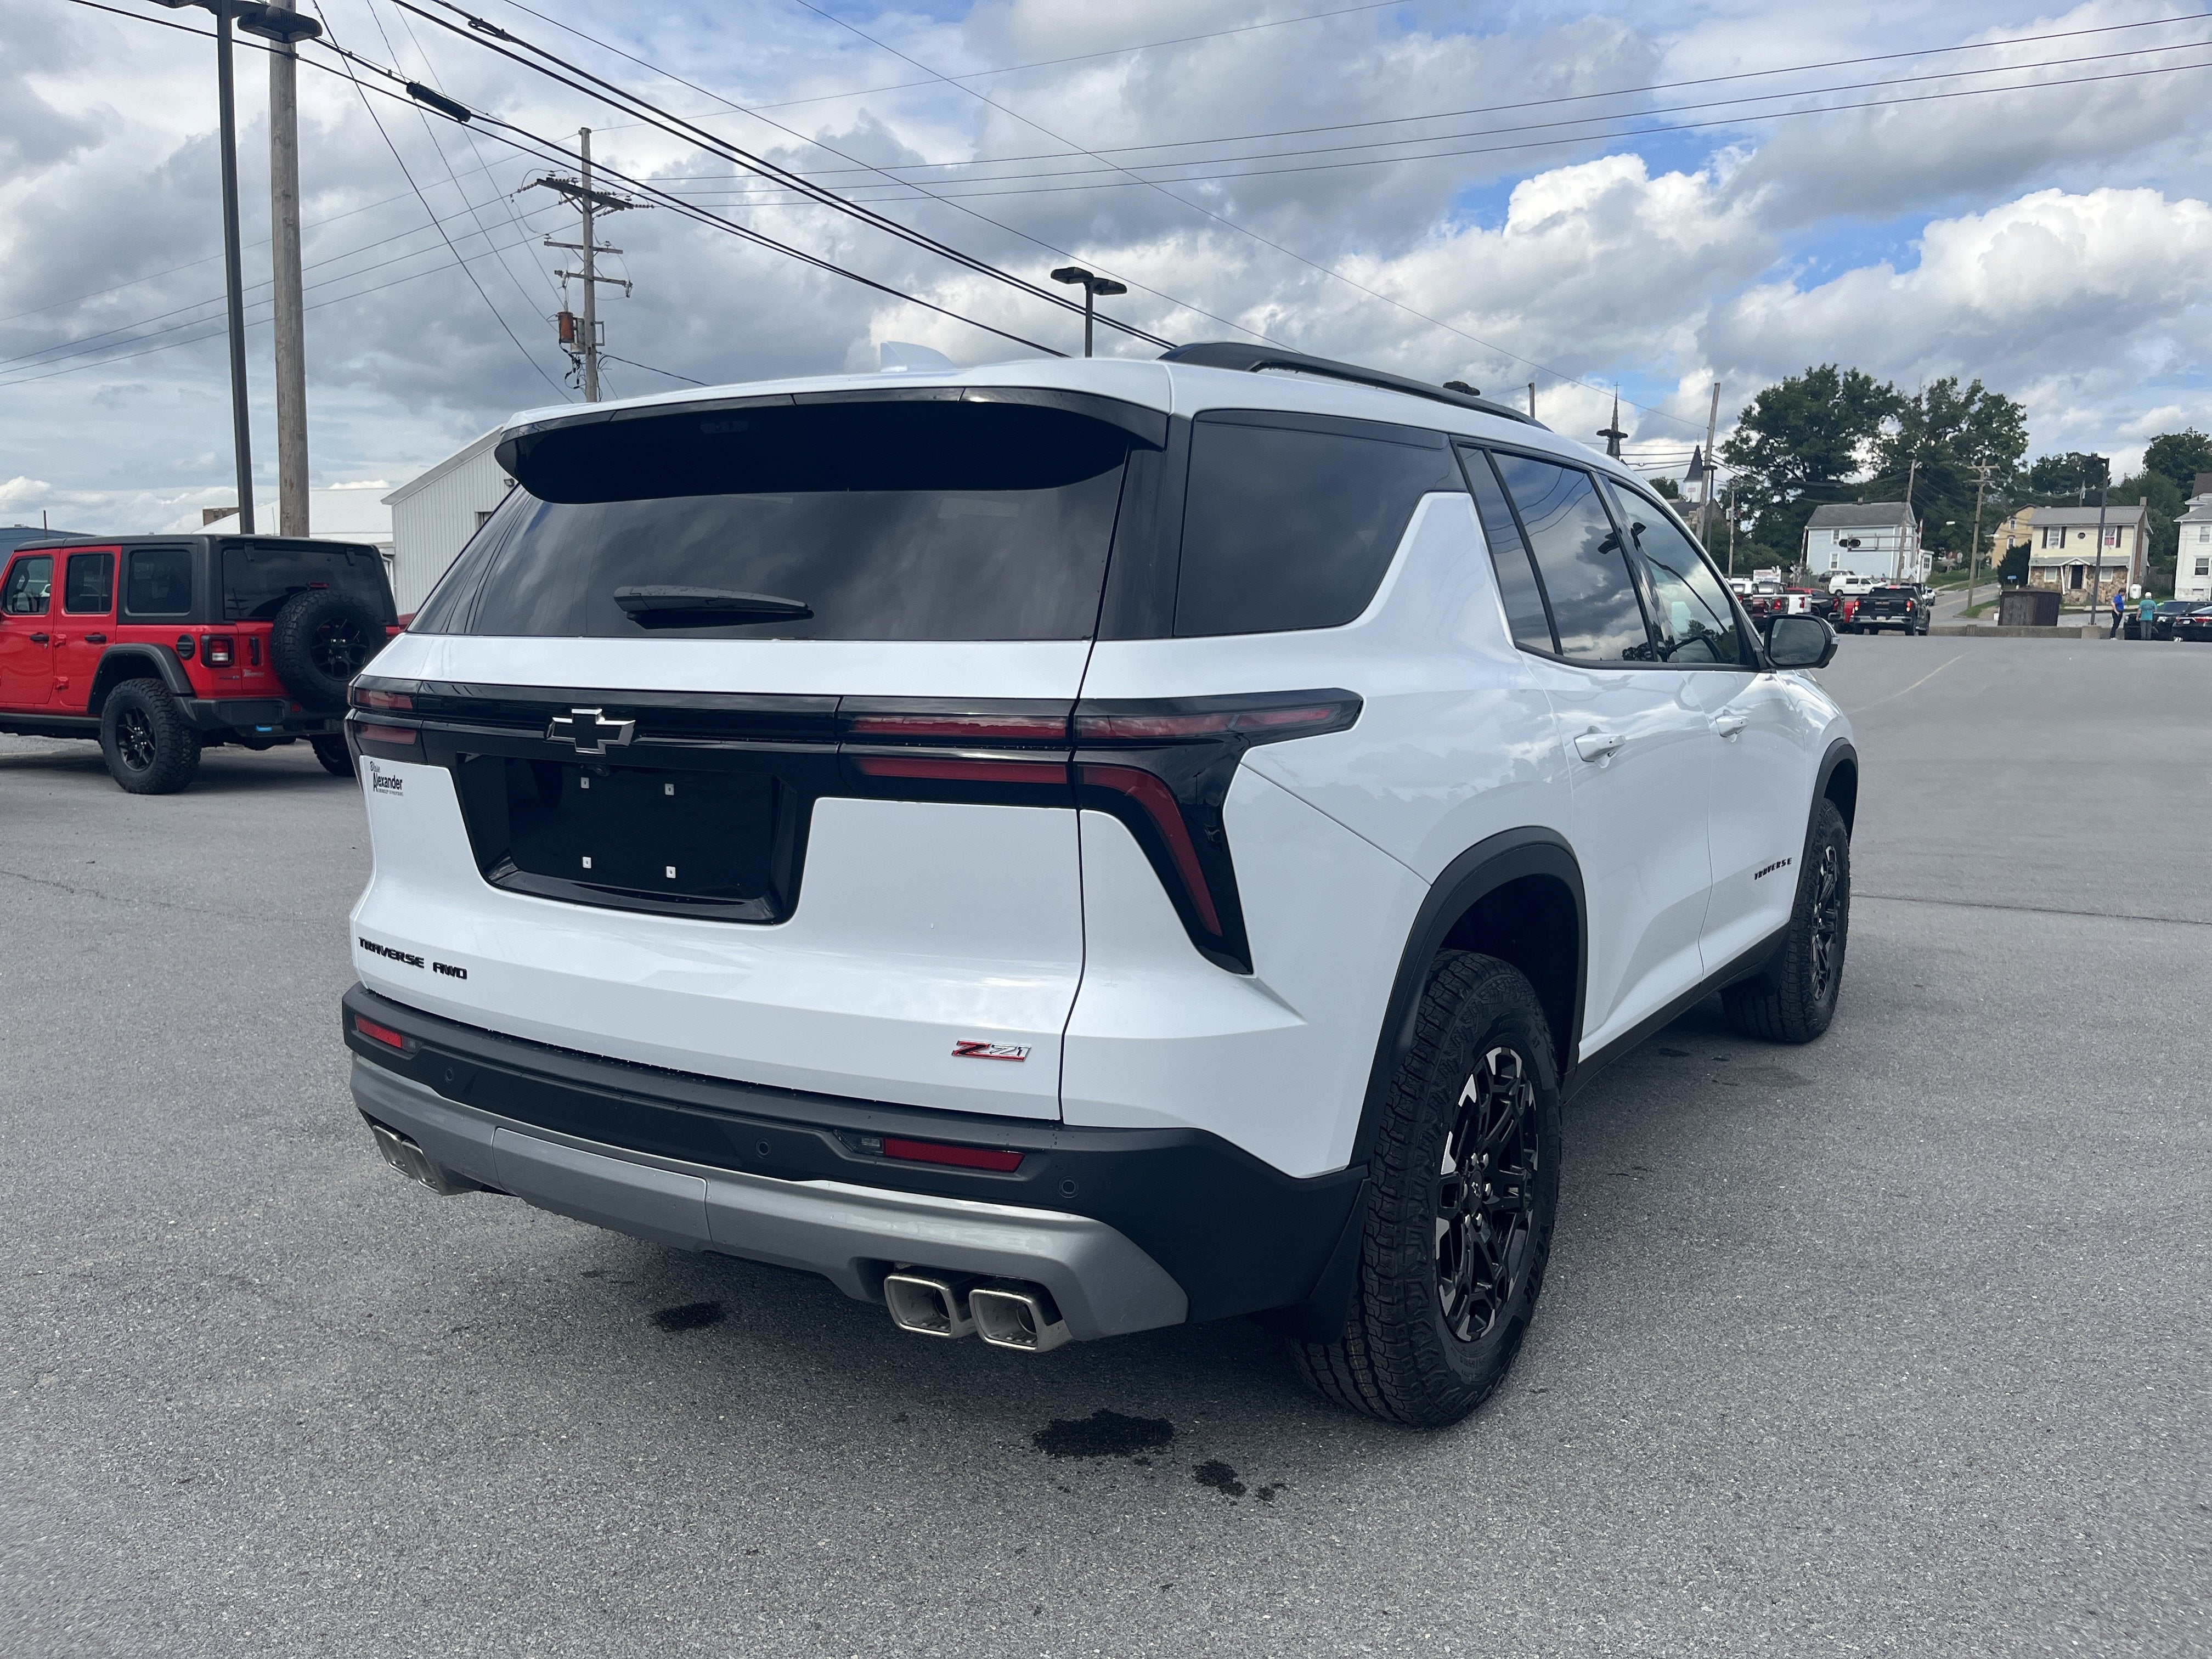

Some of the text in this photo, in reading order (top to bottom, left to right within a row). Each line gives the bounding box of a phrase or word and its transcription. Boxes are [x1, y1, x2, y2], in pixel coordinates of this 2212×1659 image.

[373, 772, 403, 792] Alexander
[1754, 857, 1792, 880] TRAVERSE
[358, 936, 467, 980] TRAVERSE AWD
[952, 1040, 1031, 1062] Z71
